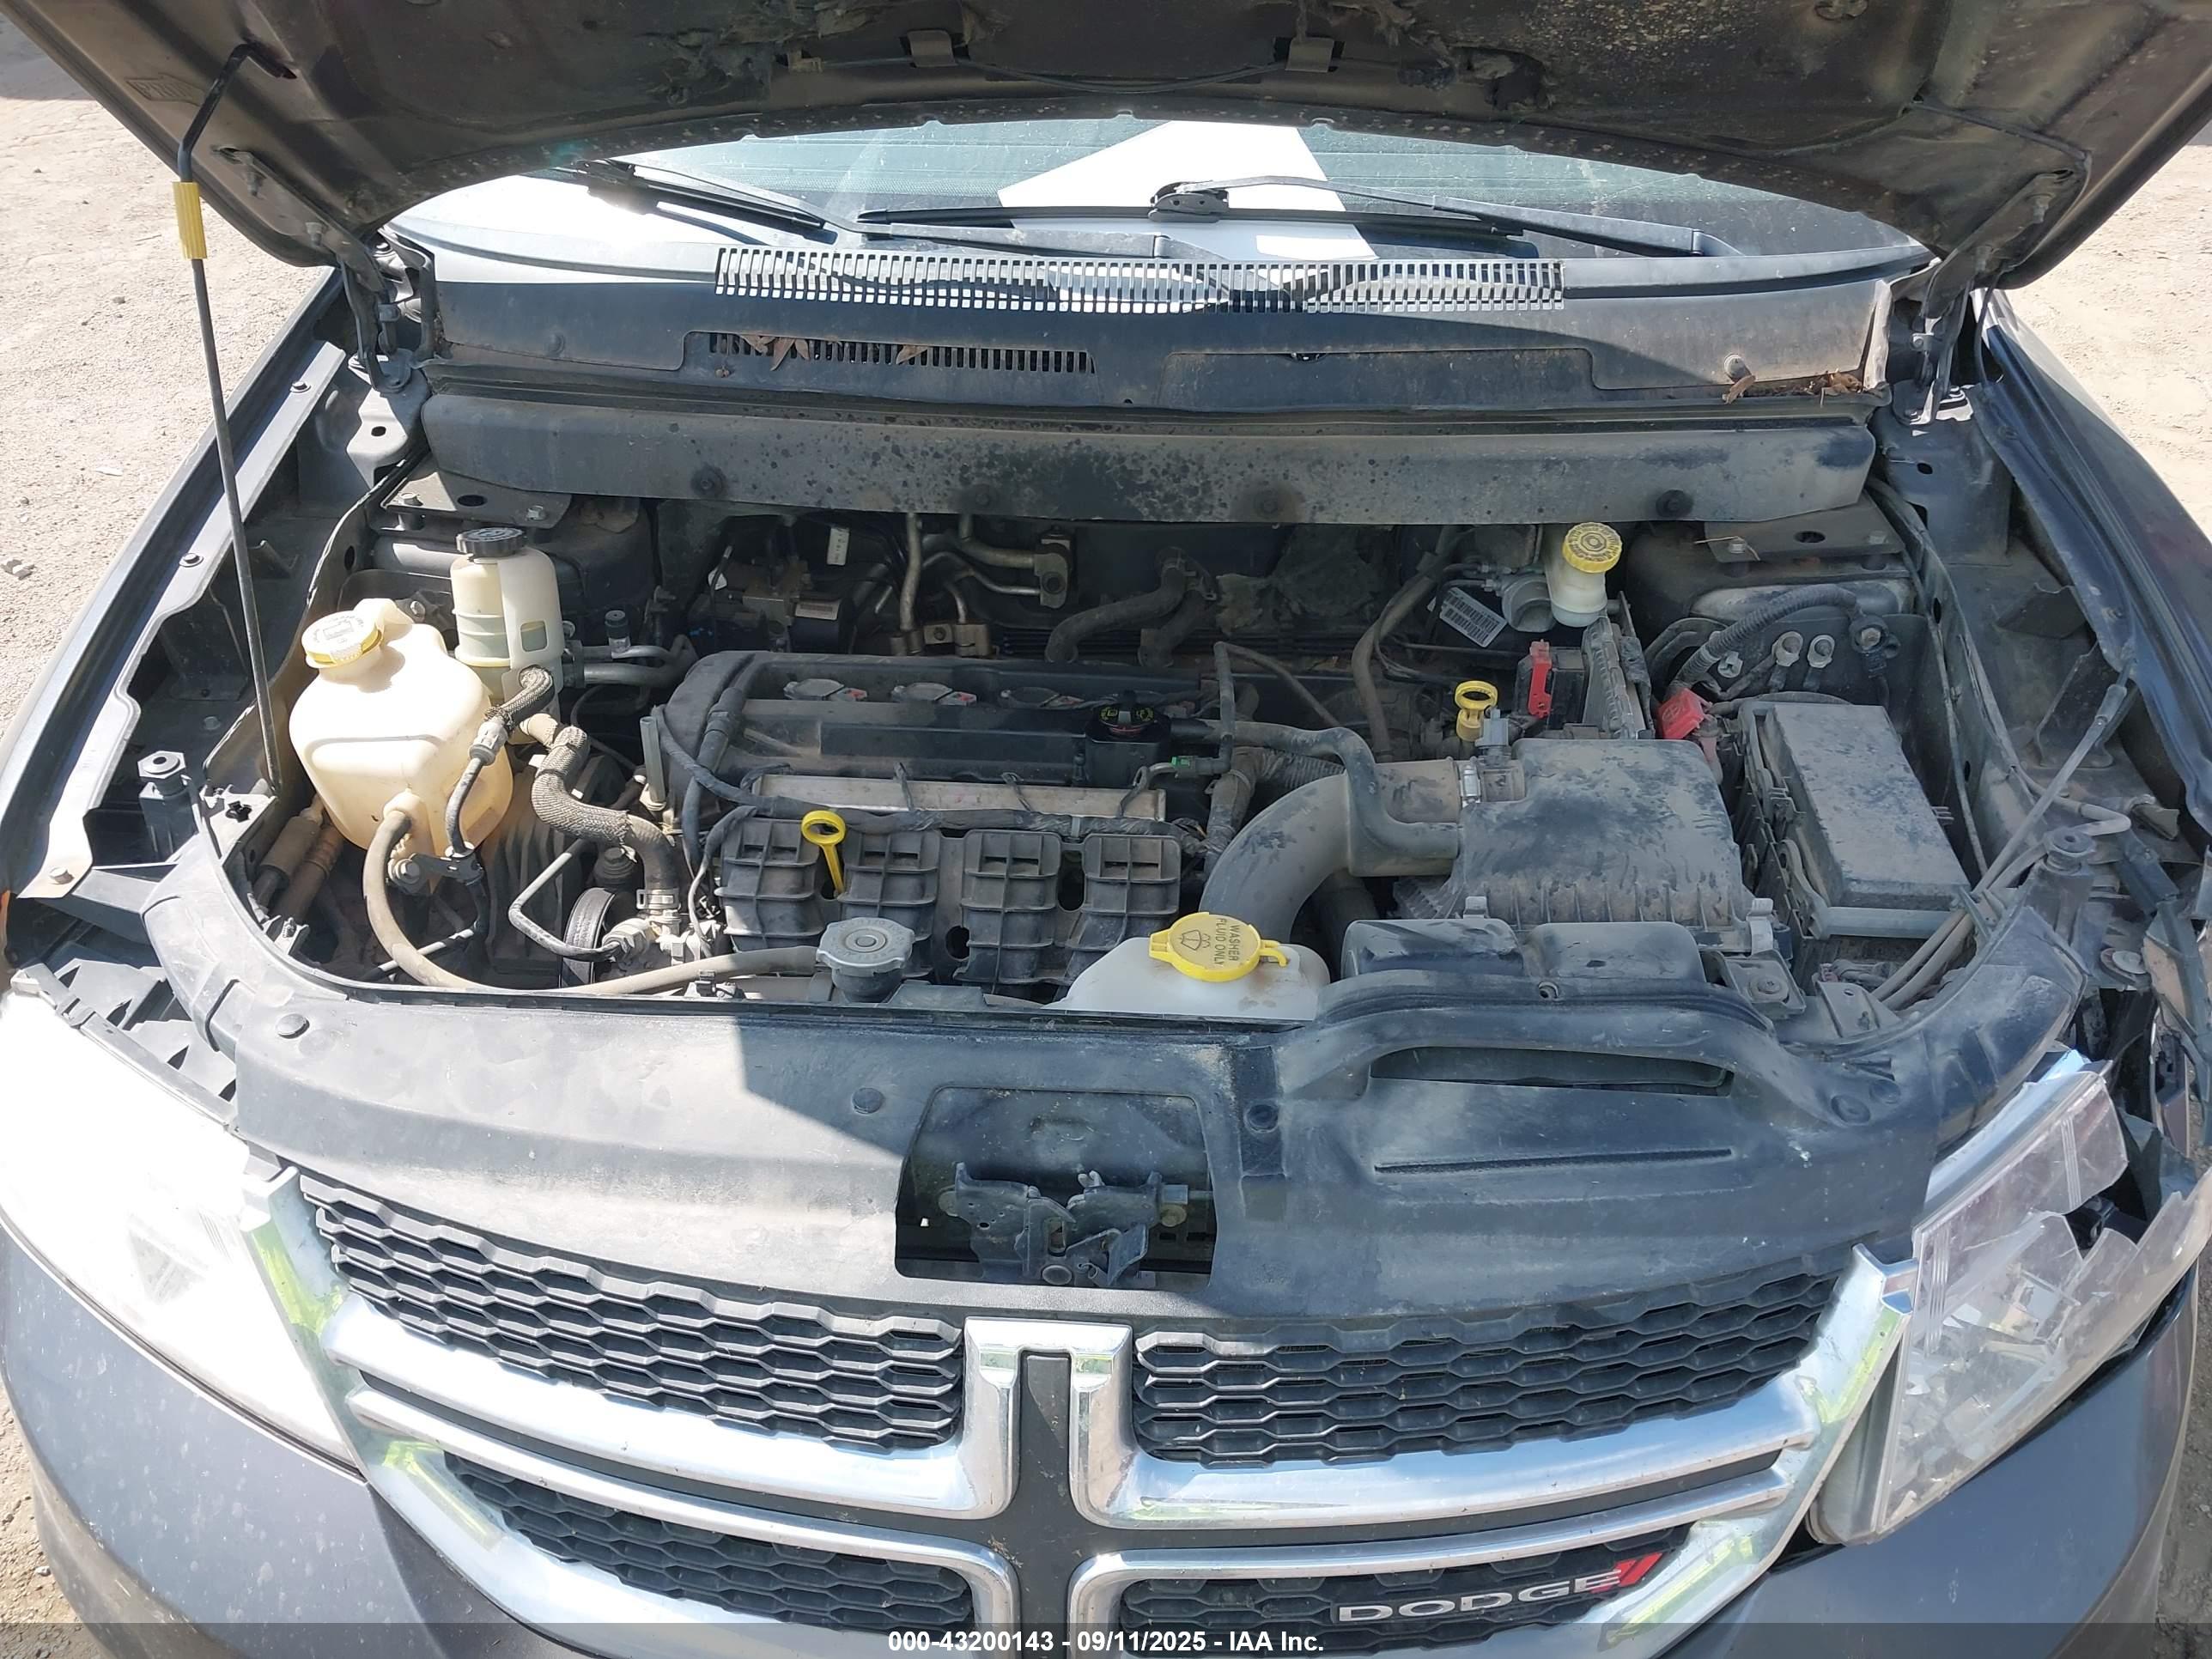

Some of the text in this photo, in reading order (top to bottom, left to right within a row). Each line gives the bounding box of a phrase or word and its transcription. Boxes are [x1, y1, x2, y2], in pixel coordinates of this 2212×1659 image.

[1213, 918, 1227, 965] FLUID ONLY
[1228, 924, 1241, 961] WASHER
[1339, 1570, 1622, 1621] DODGE
